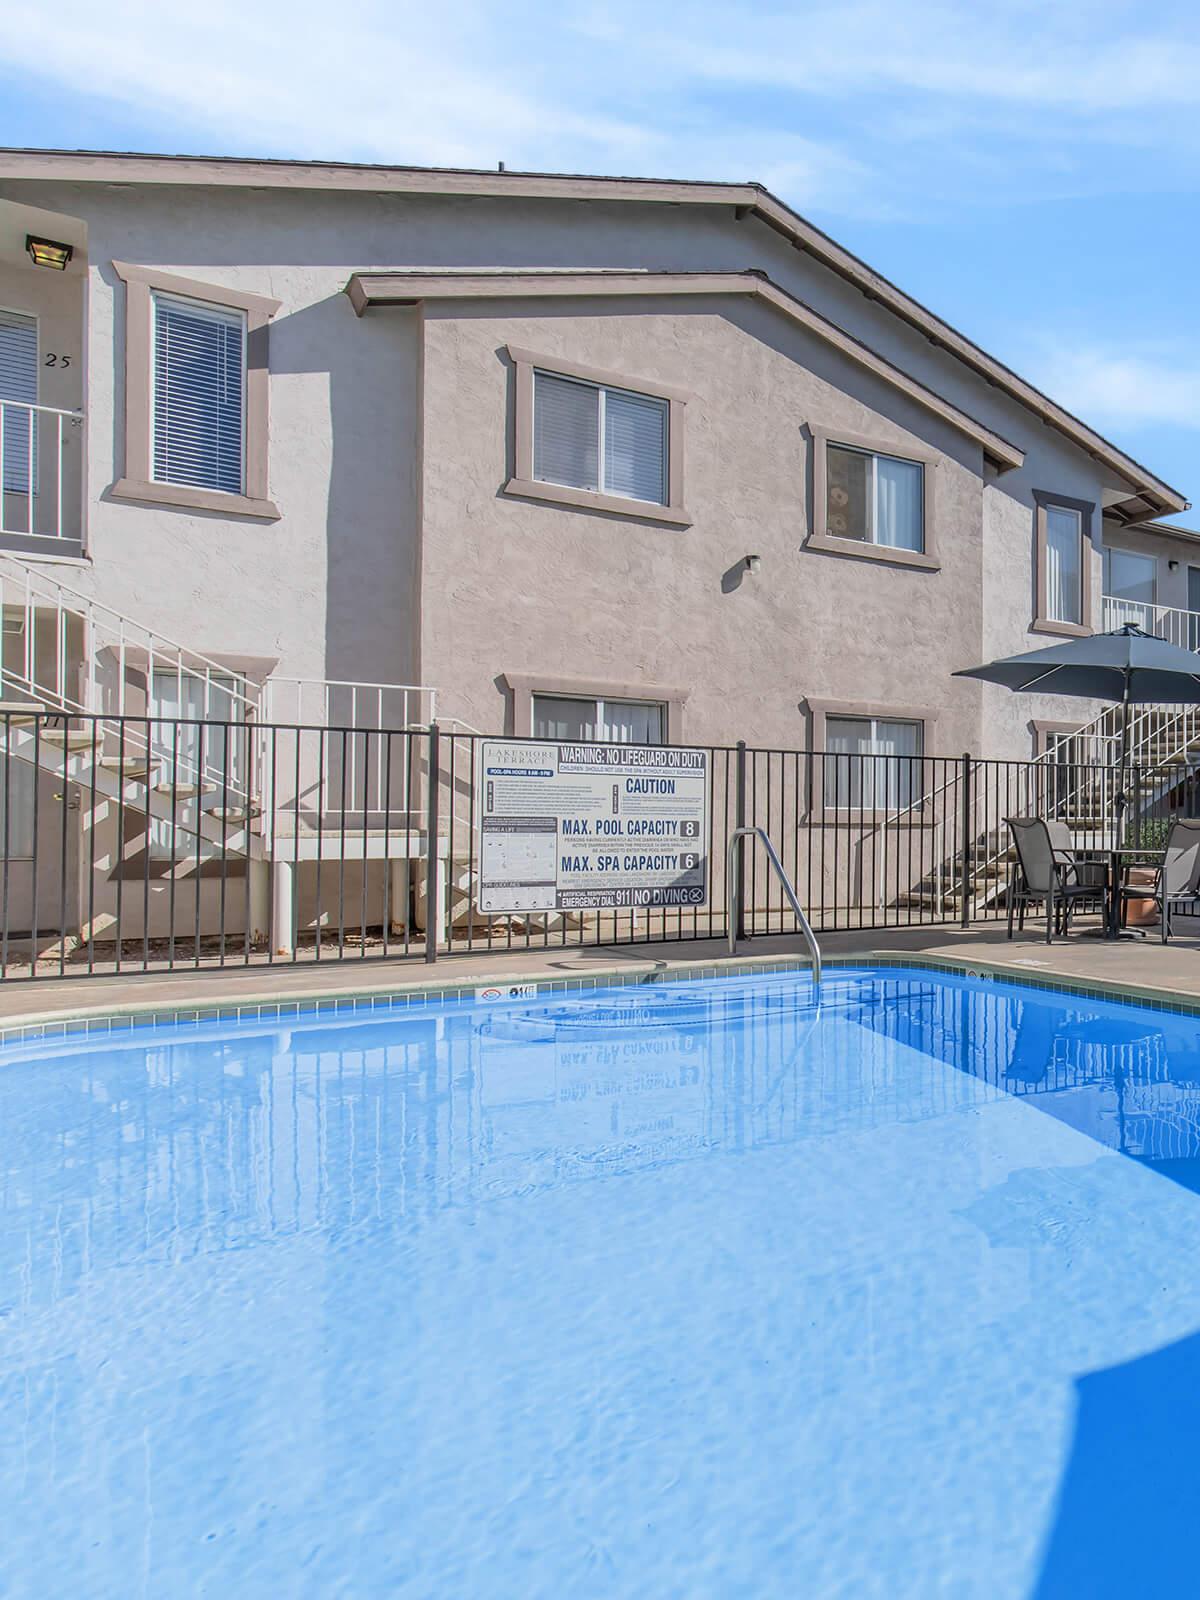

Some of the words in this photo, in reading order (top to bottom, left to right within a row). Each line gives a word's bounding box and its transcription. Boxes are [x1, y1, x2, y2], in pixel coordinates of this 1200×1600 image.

[45, 353, 72, 368] 25
[561, 747, 605, 763] WARNING:
[607, 749, 619, 764] NO
[621, 750, 667, 766] LIFEGUARD
[668, 752, 681, 767] ON
[682, 753, 703, 768] DUTY
[626, 778, 675, 794] CAUTION
[562, 819, 592, 835] MAX.
[596, 820, 624, 835] POOL
[627, 820, 678, 835] CAPACITY
[686, 822, 694, 836] 8
[561, 856, 593, 872] MAX.
[597, 856, 620, 871] SPA
[624, 855, 678, 870] CAPACITY
[685, 855, 694, 868] 6
[562, 897, 600, 907] EMERGENCY
[601, 896, 616, 905] DIAL
[616, 889, 631, 905] 911
[635, 889, 651, 905] NO
[653, 888, 689, 904] DIVING
